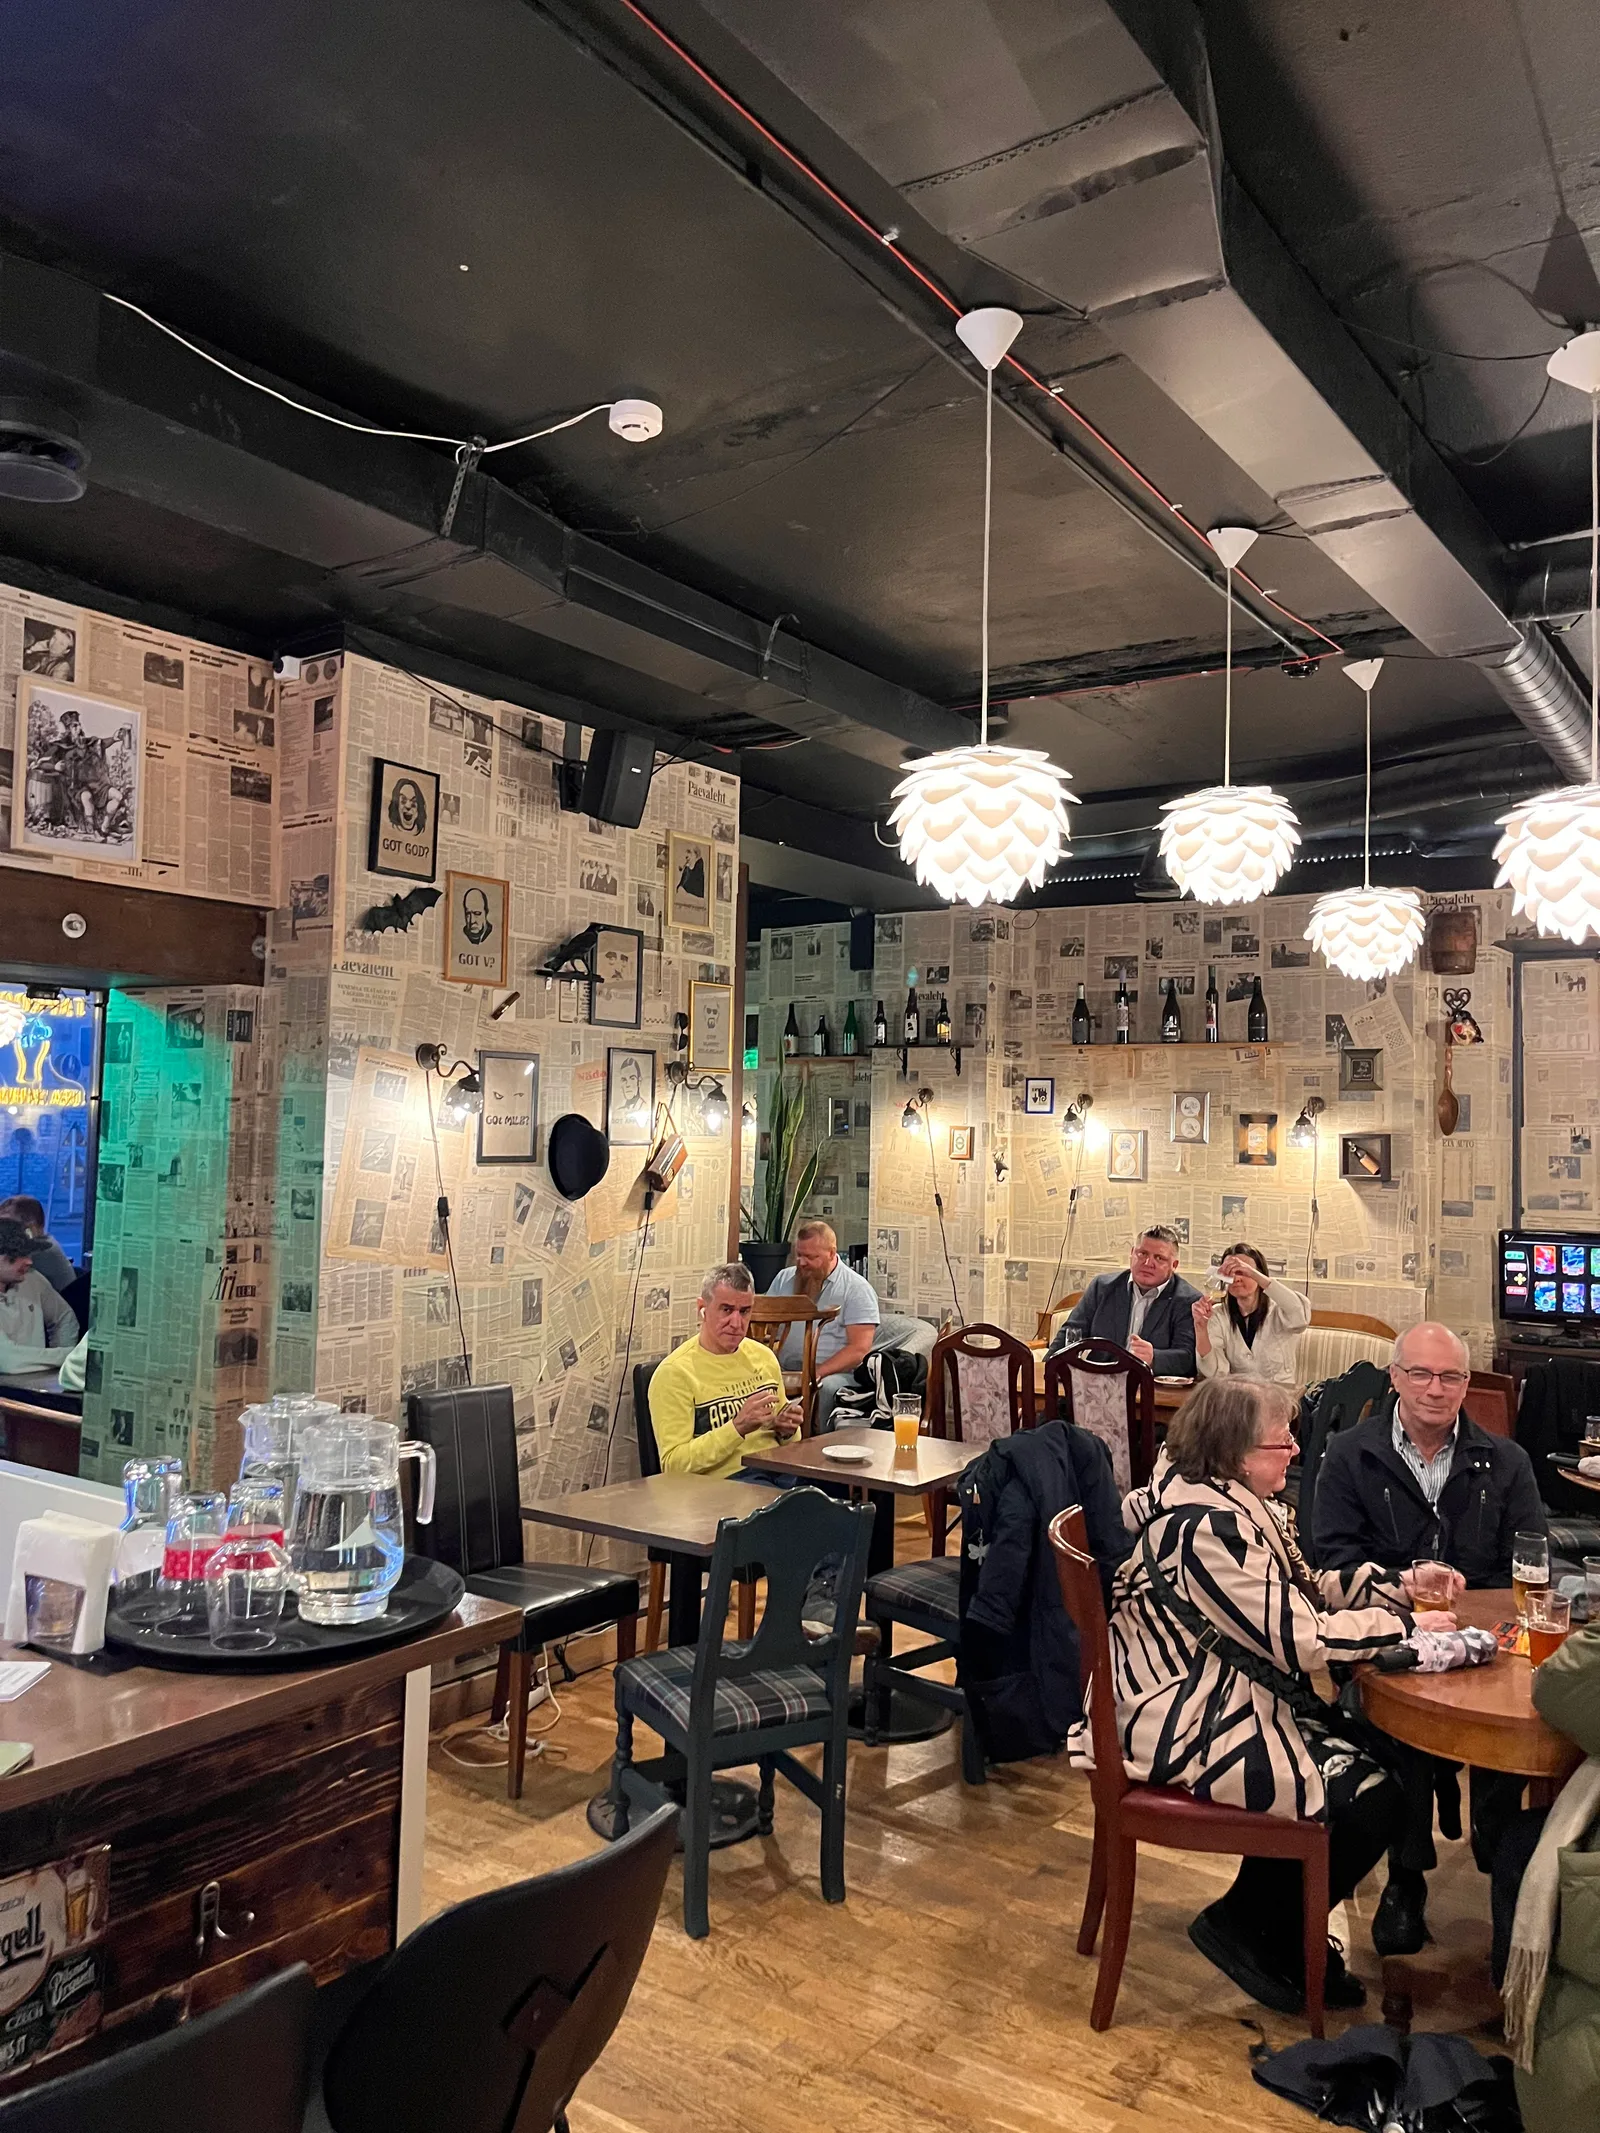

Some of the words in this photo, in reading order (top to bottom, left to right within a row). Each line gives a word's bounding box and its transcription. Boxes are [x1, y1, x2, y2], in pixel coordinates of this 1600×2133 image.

[382, 838, 403, 853] GOT
[405, 843, 430, 859] GOD?
[458, 953, 479, 967] GOT
[483, 956, 495, 968] V?
